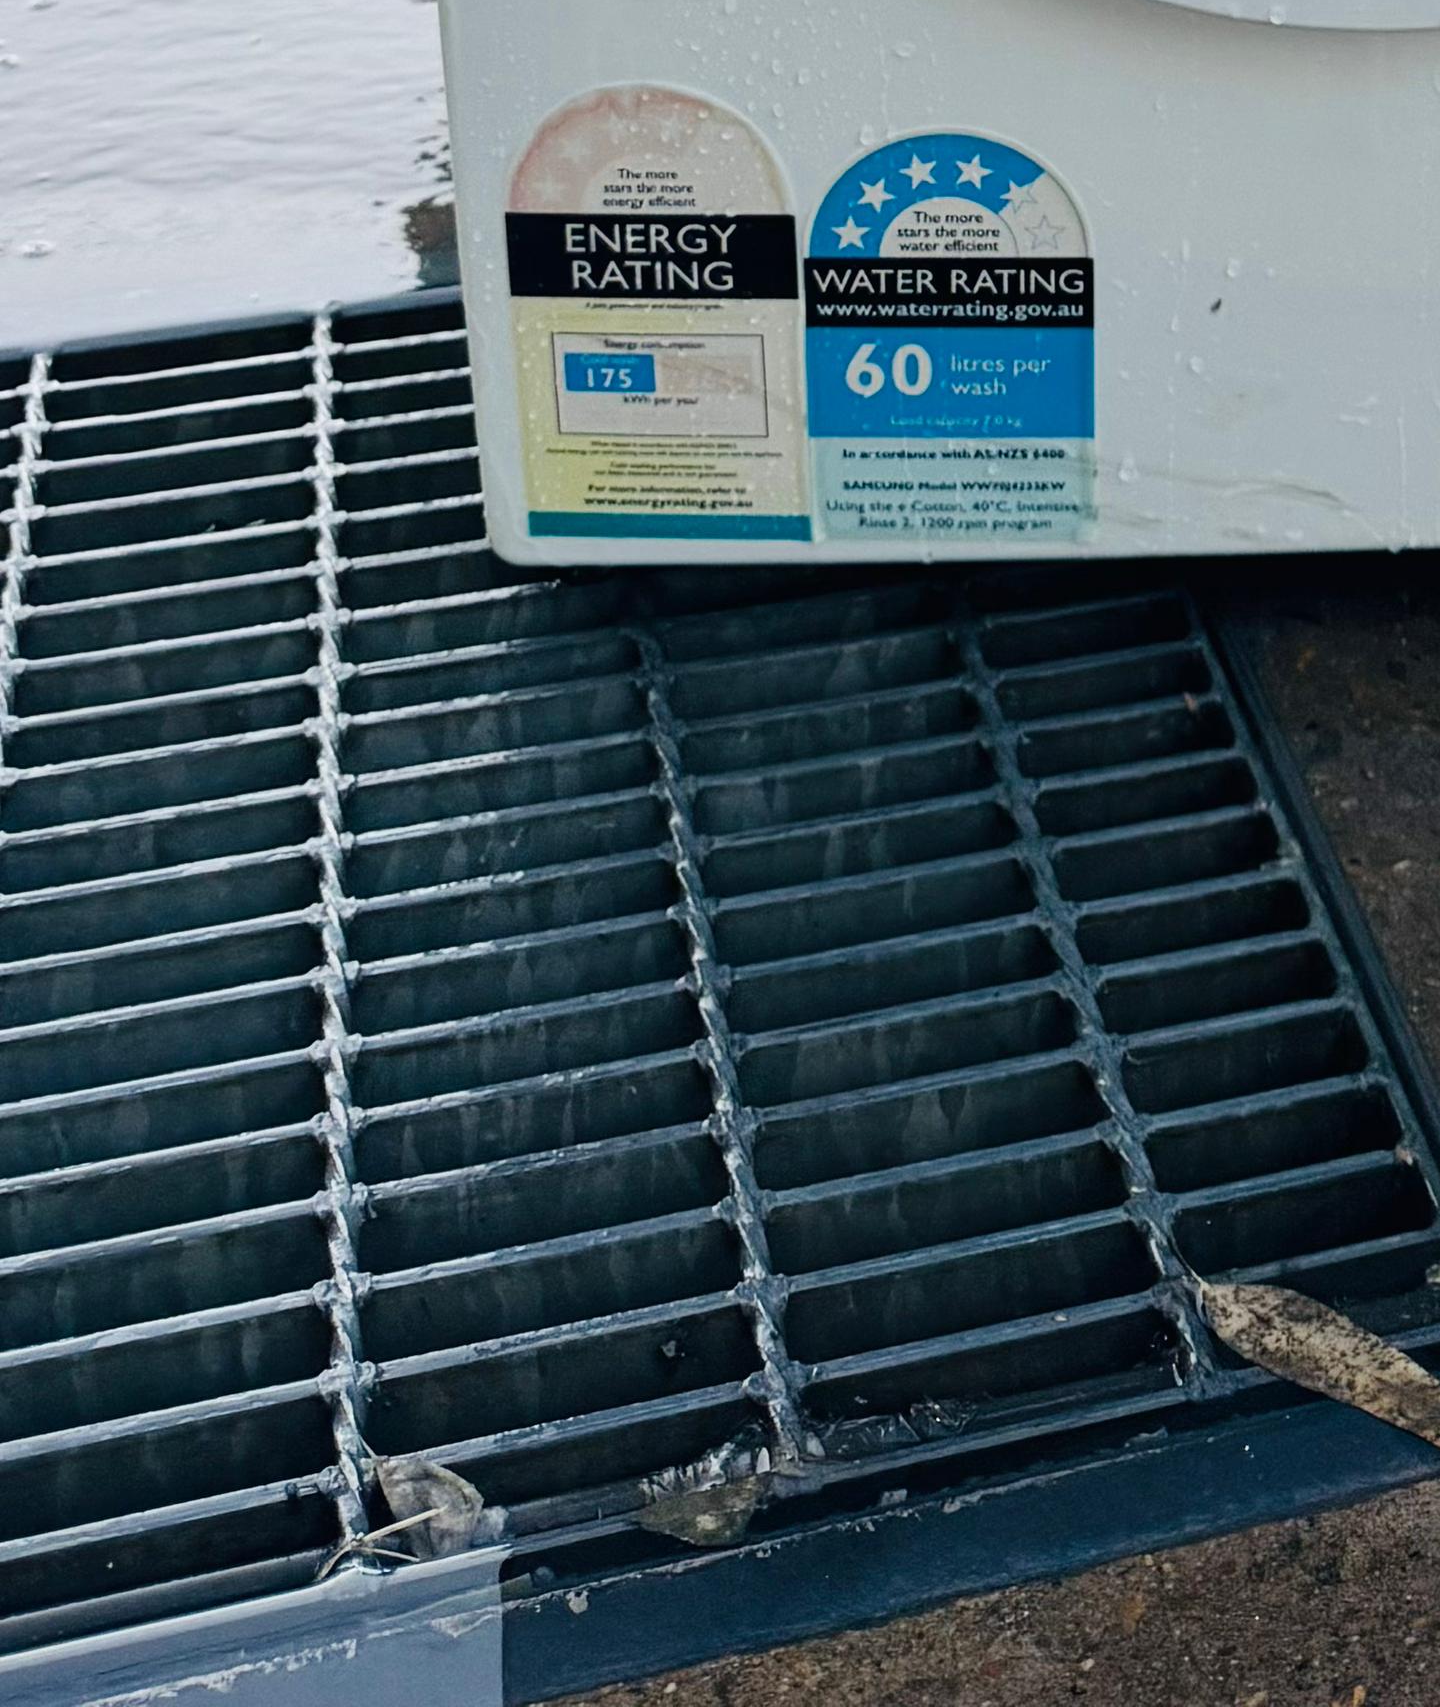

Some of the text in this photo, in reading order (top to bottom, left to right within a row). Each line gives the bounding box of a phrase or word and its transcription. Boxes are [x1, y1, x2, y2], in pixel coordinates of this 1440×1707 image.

[617, 168, 641, 179] The
[603, 198, 644, 209] energy
[914, 211, 983, 223] The more
[565, 223, 737, 254] ENERGY
[897, 226, 1000, 237] stars the more
[900, 240, 999, 252] water efficient
[571, 260, 735, 290] RATING
[812, 269, 1085, 295] WATER RATING
[816, 301, 1084, 322] www.waterrating.gov.au
[845, 343, 933, 397] 60
[951, 355, 1050, 377] litres per
[587, 368, 632, 388] 175
[951, 378, 1006, 395] wash
